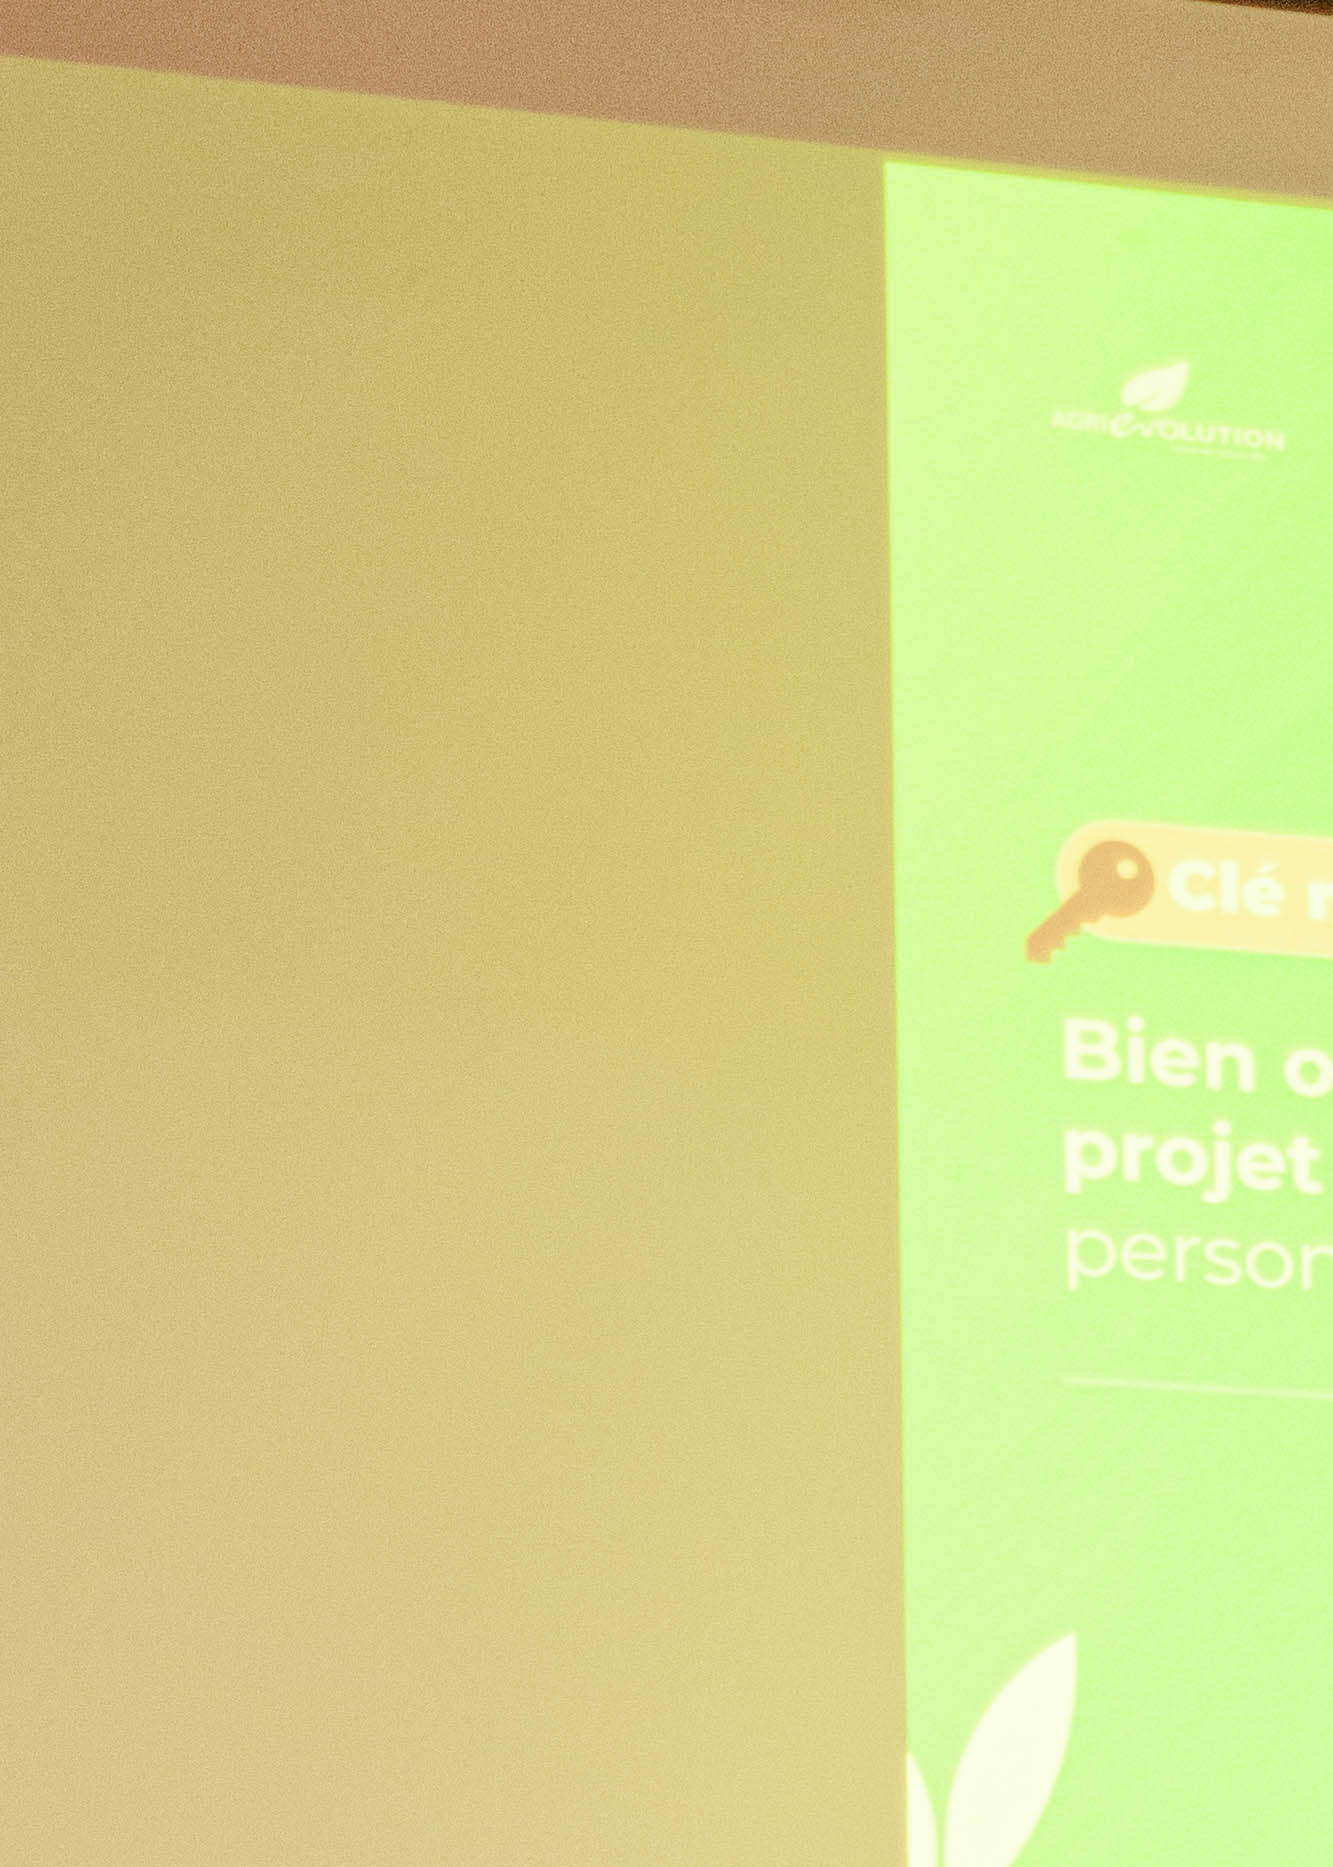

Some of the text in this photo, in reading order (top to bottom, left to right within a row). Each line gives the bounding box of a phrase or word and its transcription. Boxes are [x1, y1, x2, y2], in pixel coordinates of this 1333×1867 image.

[1168, 857, 1283, 916] Clé
[1063, 1015, 1257, 1093] Bien
[1064, 1121, 1324, 1203] projet
